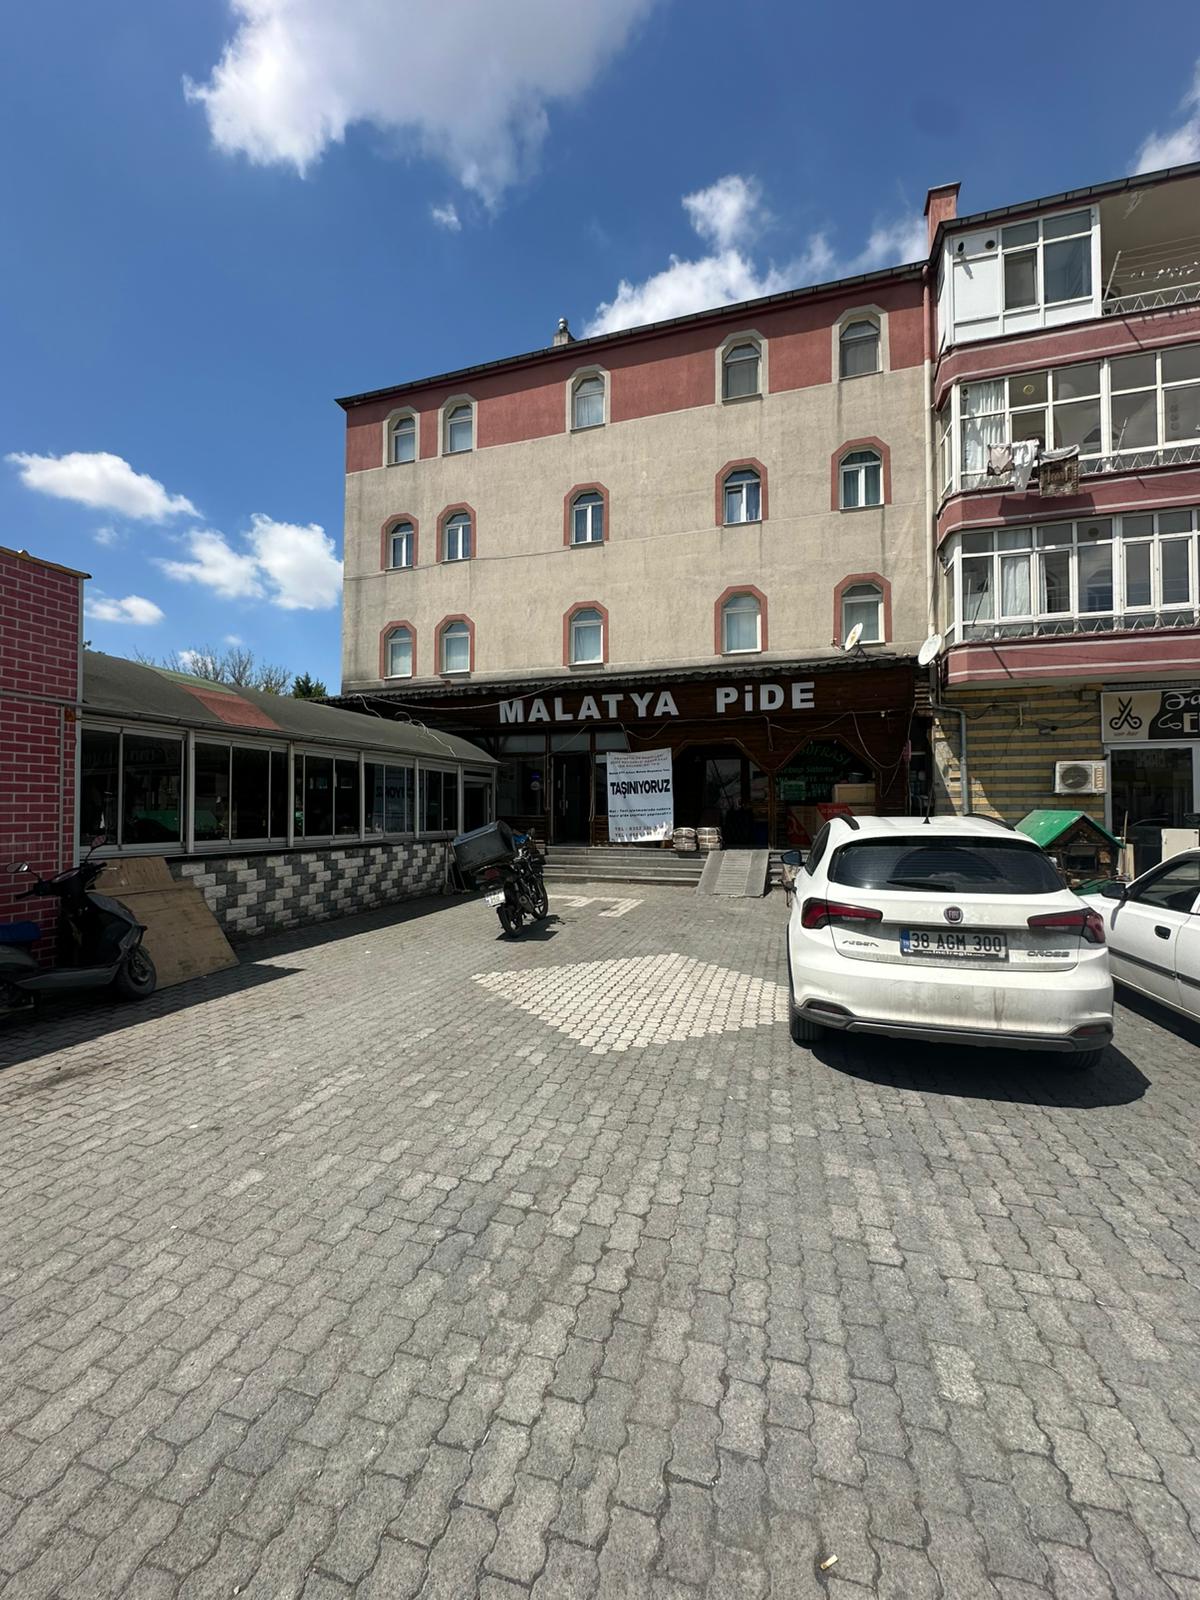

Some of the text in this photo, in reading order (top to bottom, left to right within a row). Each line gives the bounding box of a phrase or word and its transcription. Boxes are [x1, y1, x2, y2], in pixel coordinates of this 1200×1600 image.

[499, 690, 680, 724] MALATYA
[610, 778, 671, 799] TAŞINIYORUZ
[911, 932, 1003, 953] 38 AGM 300
